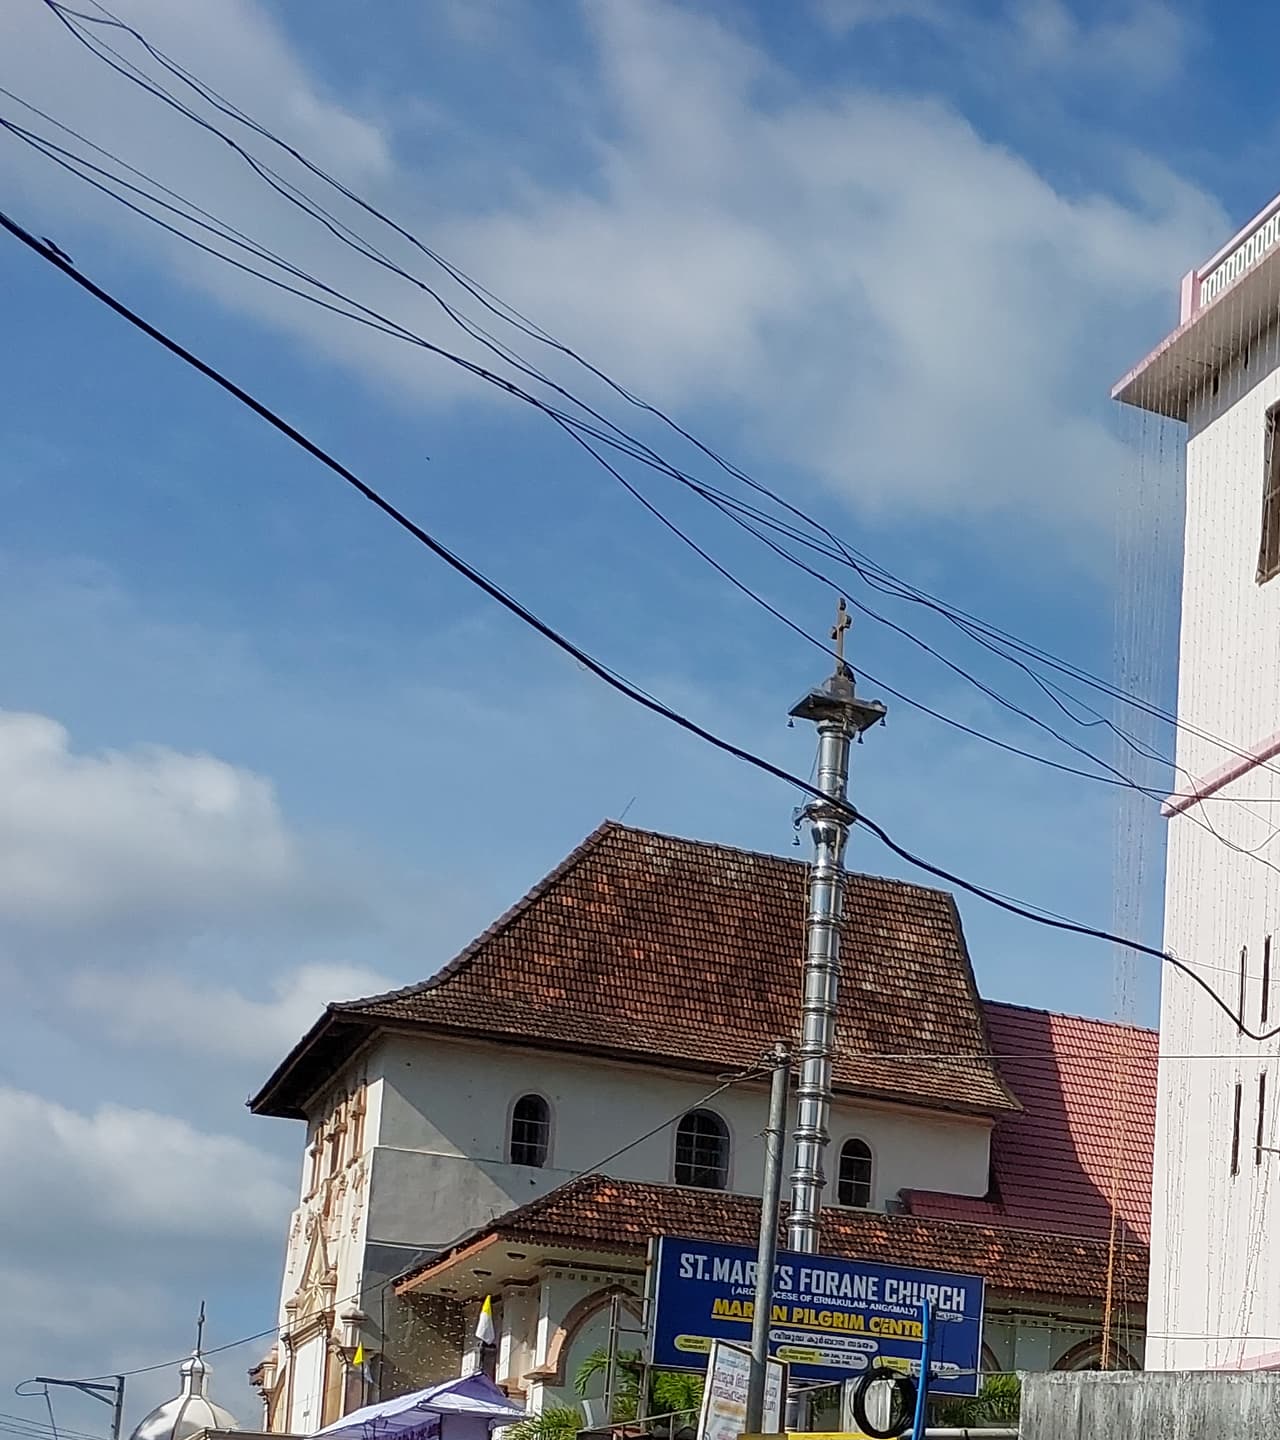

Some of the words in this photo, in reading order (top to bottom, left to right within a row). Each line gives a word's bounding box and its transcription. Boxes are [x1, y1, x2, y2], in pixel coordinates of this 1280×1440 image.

[679, 1253, 793, 1291] ST.MAR'S
[800, 1268, 879, 1301] FORANE
[885, 1279, 966, 1312] CHURCH
[731, 1287, 799, 1302] (ARCOCESE
[801, 1295, 812, 1304] OF
[712, 1298, 788, 1321] MARN
[792, 1307, 864, 1330] PILGRIM
[869, 1317, 922, 1337] CENTR
